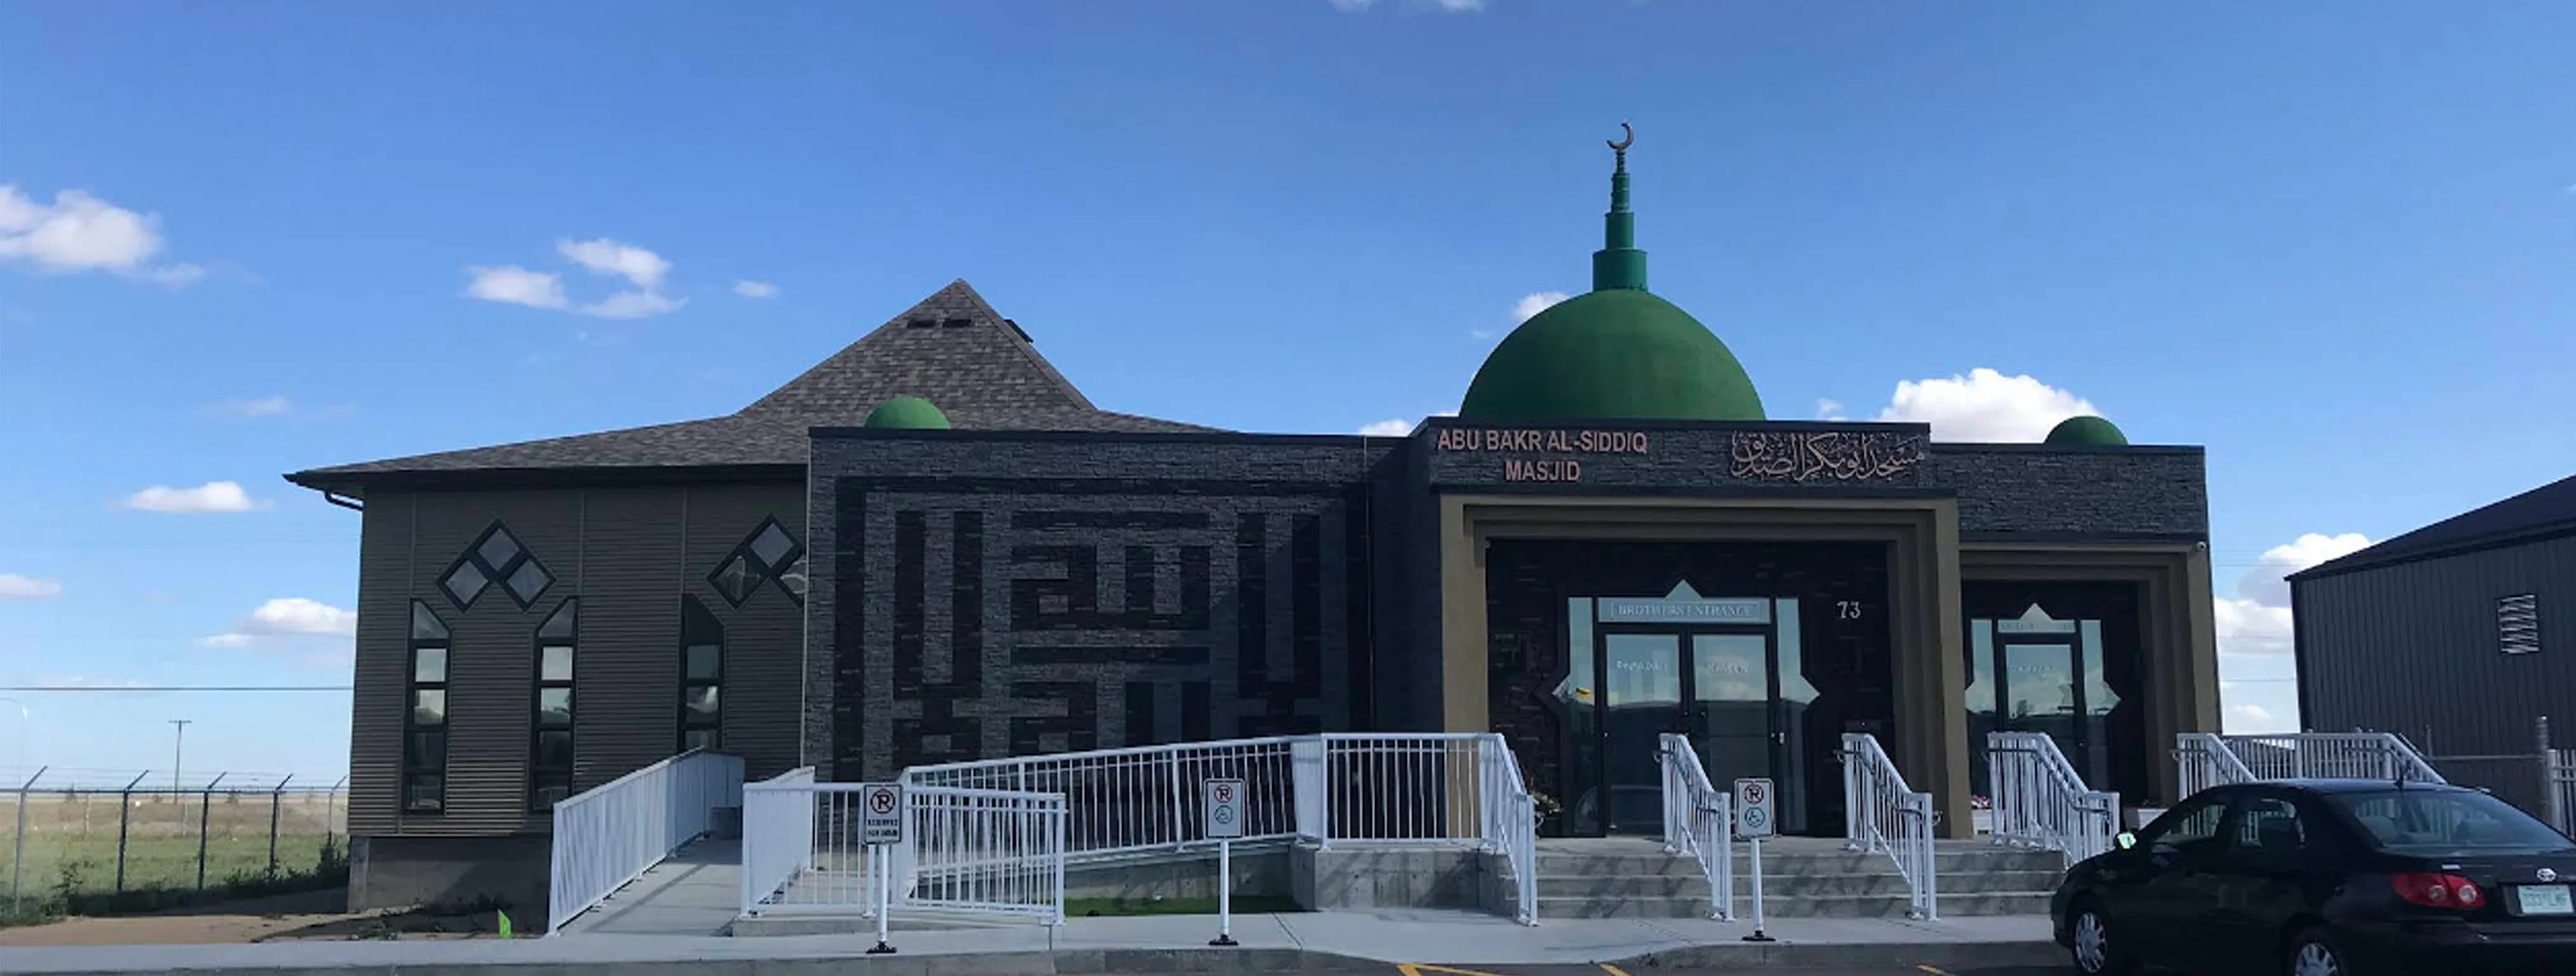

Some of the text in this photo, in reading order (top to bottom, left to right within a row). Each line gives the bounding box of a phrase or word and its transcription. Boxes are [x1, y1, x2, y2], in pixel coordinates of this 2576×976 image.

[1438, 429, 1647, 454] ABU BAKR AL-SIDDIQ
[1505, 460, 1581, 481] MASJID
[1686, 605, 1753, 617] ENTRANCE
[1836, 600, 1861, 619] 73
